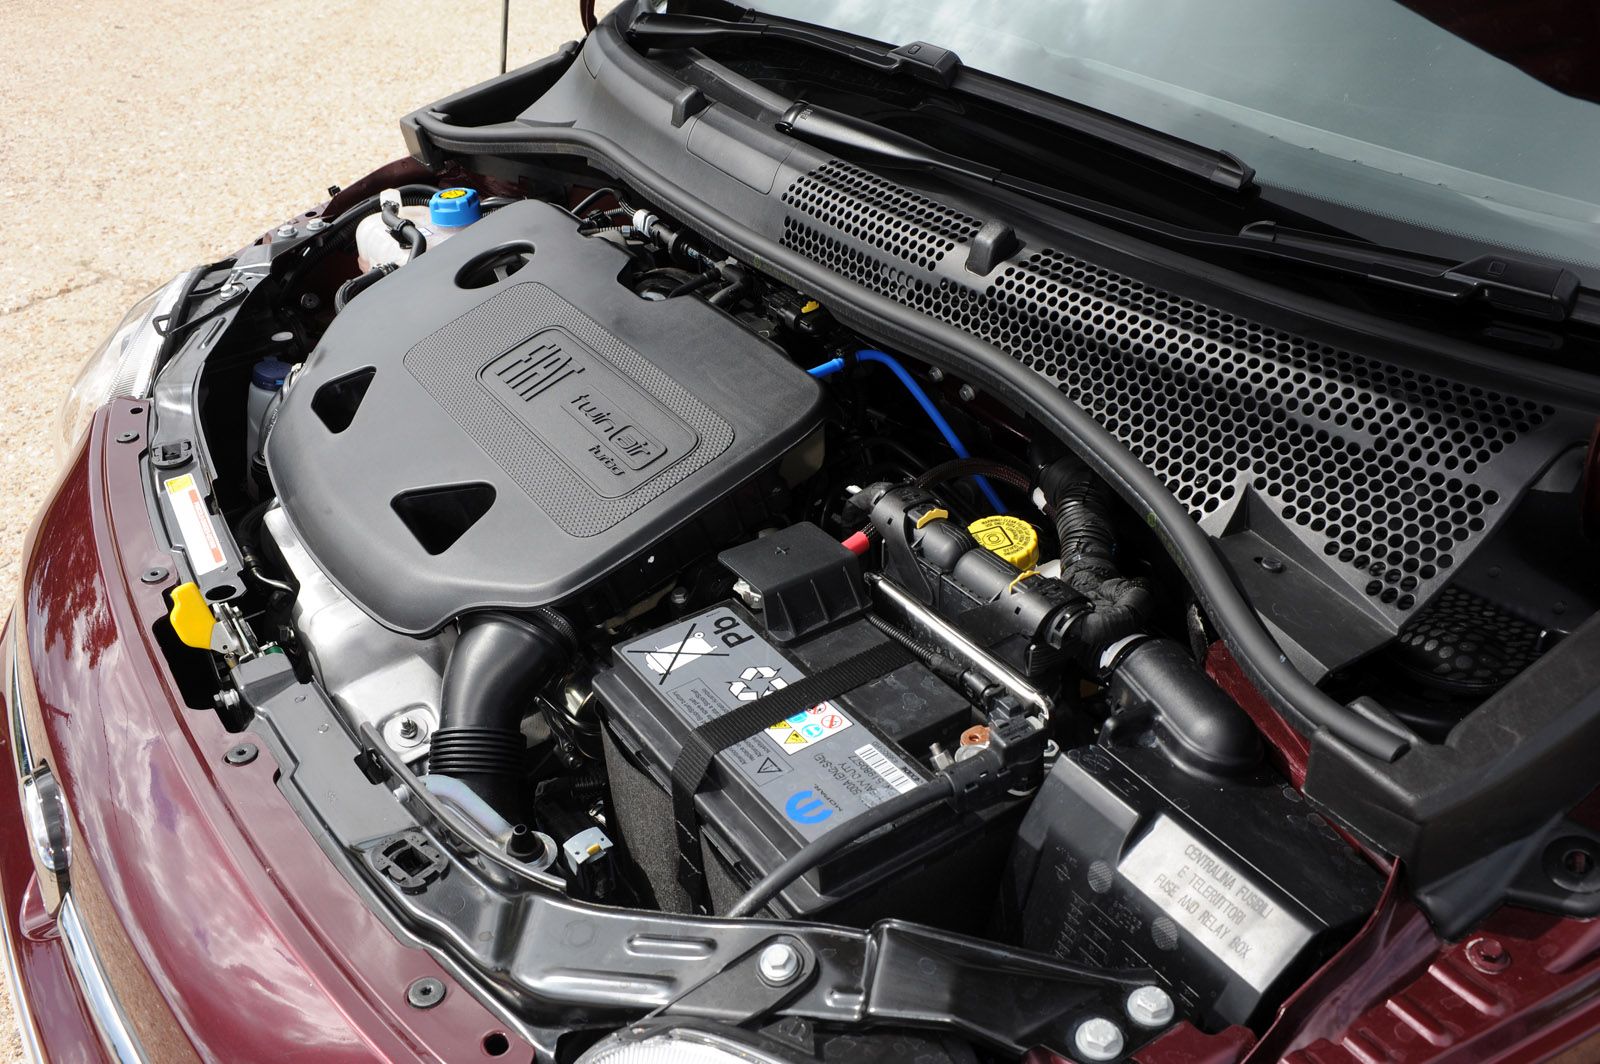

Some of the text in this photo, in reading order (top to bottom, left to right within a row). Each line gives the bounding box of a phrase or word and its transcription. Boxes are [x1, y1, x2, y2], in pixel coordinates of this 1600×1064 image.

[496, 344, 586, 402] FIAT
[588, 444, 626, 476] turbo
[713, 616, 754, 648] Pb
[837, 760, 862, 779] DUTY
[846, 753, 885, 784] 51980577
[842, 779, 860, 795] 500A
[1177, 866, 1248, 926] E TELERUTTORI
[1185, 844, 1273, 919] CENTRALINA FUSIBILI
[1154, 875, 1252, 960] FUSE AND RELAY BOX
